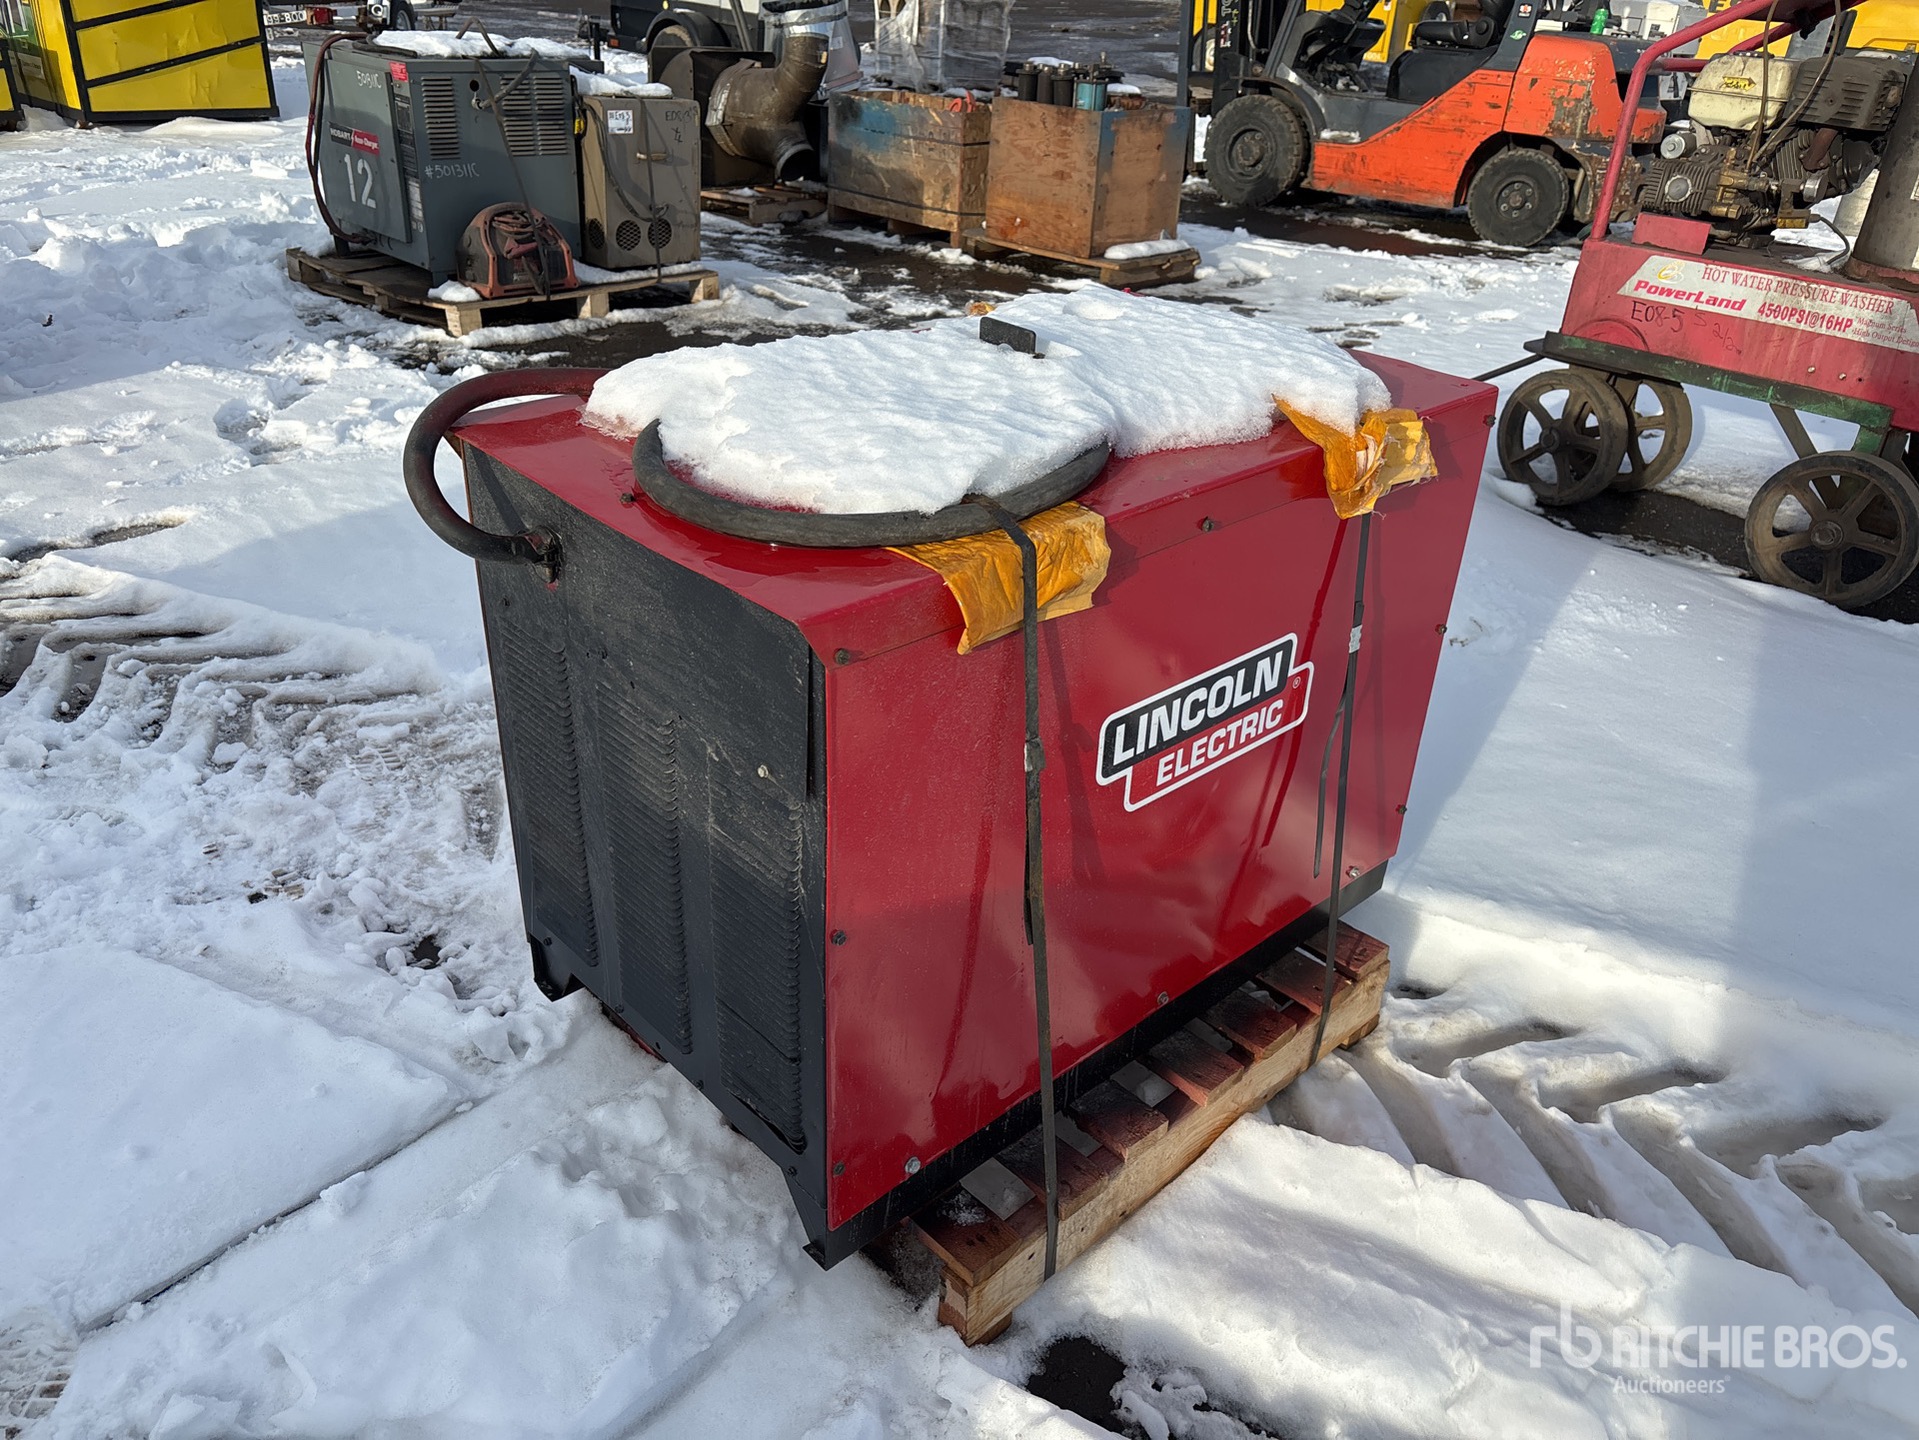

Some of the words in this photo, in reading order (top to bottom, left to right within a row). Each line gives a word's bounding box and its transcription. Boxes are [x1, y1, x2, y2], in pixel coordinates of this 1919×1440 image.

[344, 153, 377, 209] 12
[1633, 279, 1748, 312] PowerLand
[1702, 267, 1730, 283] HOT
[1732, 273, 1773, 292] WATER
[1774, 279, 1838, 305] PRESSURE
[1840, 292, 1895, 315] WASHER
[1112, 650, 1285, 766] LINCOLN
[1156, 698, 1284, 787] ELECTRIC
